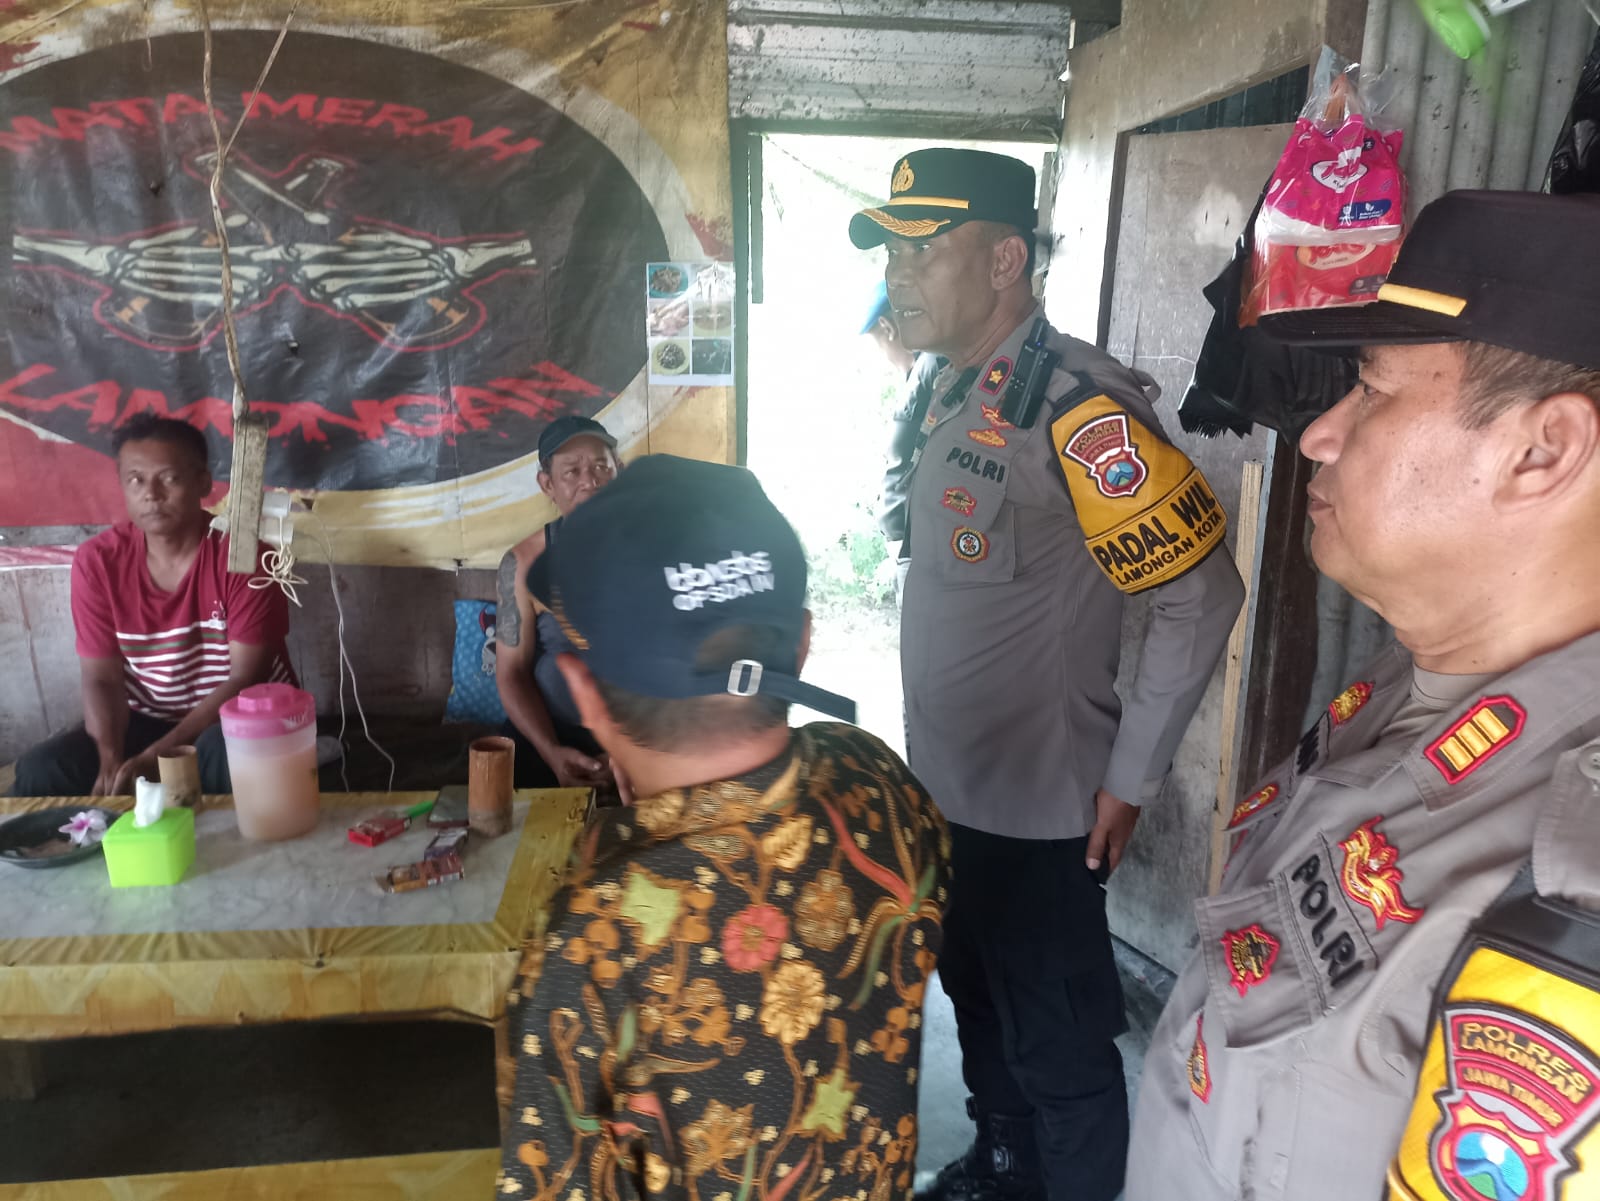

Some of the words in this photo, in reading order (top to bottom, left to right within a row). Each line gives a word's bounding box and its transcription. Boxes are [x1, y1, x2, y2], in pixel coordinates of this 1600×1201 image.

[241, 92, 544, 161] MERAH
[946, 447, 1005, 483] POLRI
[1093, 516, 1180, 575] PADAL
[1171, 482, 1215, 529] WIL
[1116, 539, 1195, 586] LAMONGAN
[1194, 514, 1222, 541] KOTA
[1291, 853, 1365, 988] POLRI
[1461, 1034, 1586, 1104] LAMONGAN
[1463, 1022, 1592, 1093] POLRES
[1463, 1067, 1511, 1095] JAWA
